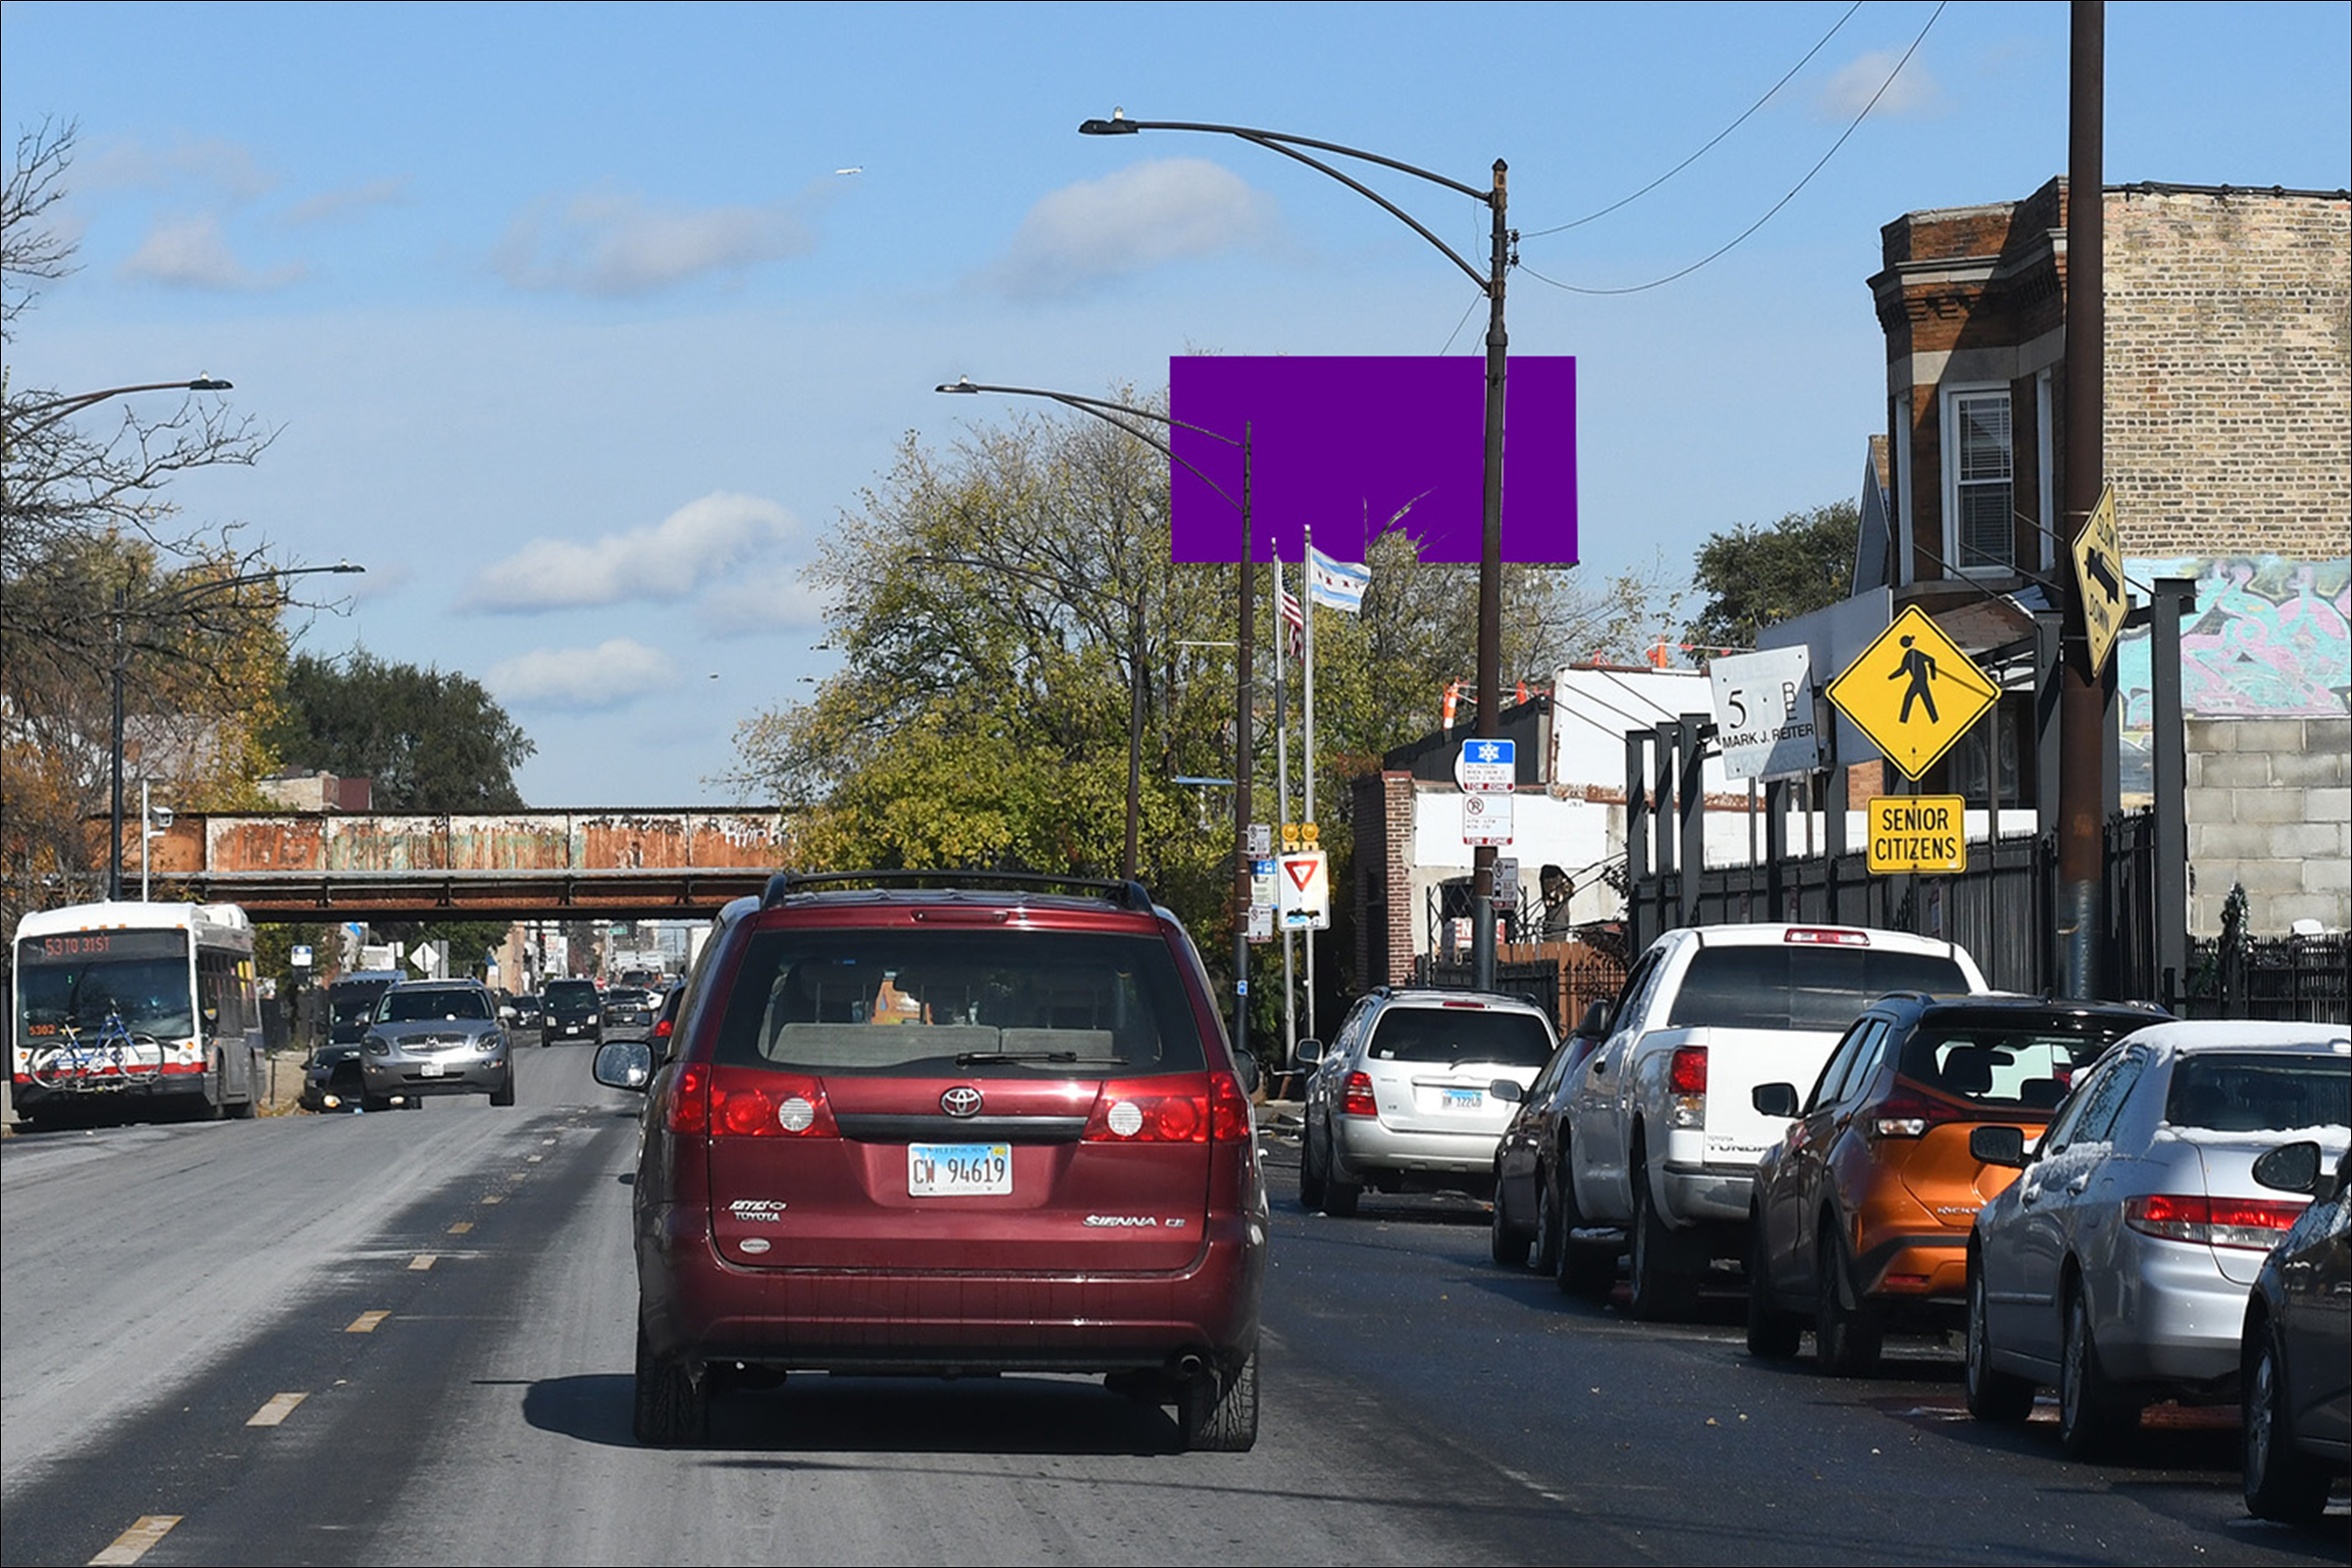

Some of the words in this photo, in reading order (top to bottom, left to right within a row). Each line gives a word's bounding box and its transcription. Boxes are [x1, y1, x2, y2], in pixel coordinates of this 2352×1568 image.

[1728, 689, 1746, 730] 5
[1722, 732, 1758, 749] MARK
[1760, 730, 1771, 744] J.
[1772, 723, 1815, 742] REITER
[1882, 808, 1949, 831] SENIOR
[1875, 837, 1957, 860] CITIZENS
[45, 938, 64, 956] 53
[65, 938, 79, 954] TO
[913, 1158, 935, 1184] CW
[948, 1157, 1005, 1184] 94619
[735, 1211, 781, 1222] TOYOTA
[1083, 1214, 1157, 1227] SIENNA
